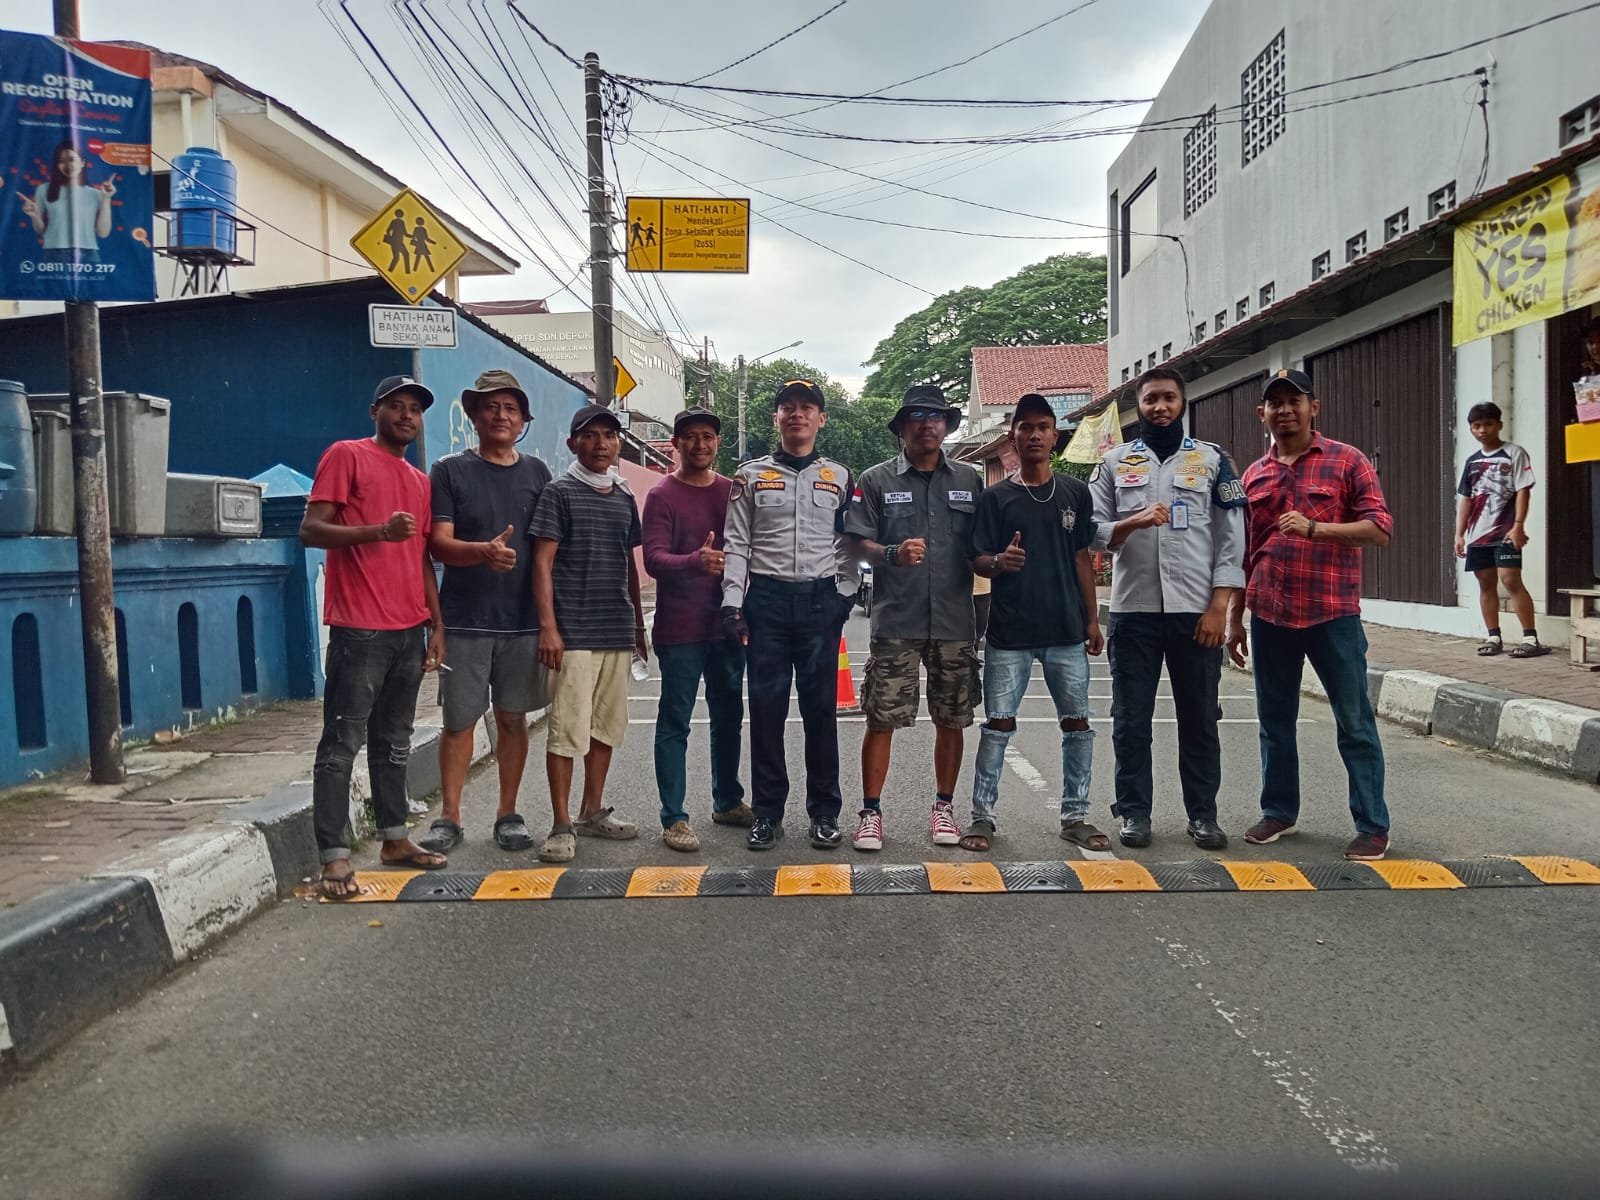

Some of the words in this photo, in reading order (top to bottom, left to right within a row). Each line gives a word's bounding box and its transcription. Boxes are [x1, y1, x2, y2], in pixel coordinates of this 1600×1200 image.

[42, 73, 94, 91] OPEN
[2, 82, 134, 108] REGISTRATION
[674, 204, 729, 215] HATI-HATI
[686, 216, 724, 226] Mendekati
[665, 227, 683, 236] Zona
[686, 227, 714, 237] Selamat
[717, 228, 745, 237] Sekolah
[1476, 222, 1547, 300] YES
[38, 262, 64, 272] 0811
[66, 263, 93, 273] 1170
[95, 264, 116, 273] 217
[1475, 277, 1547, 333] CHICKEN
[383, 311, 445, 323] HATI-HATI
[379, 322, 419, 333] BANYAK
[422, 324, 450, 334] ANAK
[392, 332, 439, 343] SEKOLAH
[538, 332, 557, 342] SDN
[559, 330, 592, 341] DEPOK
